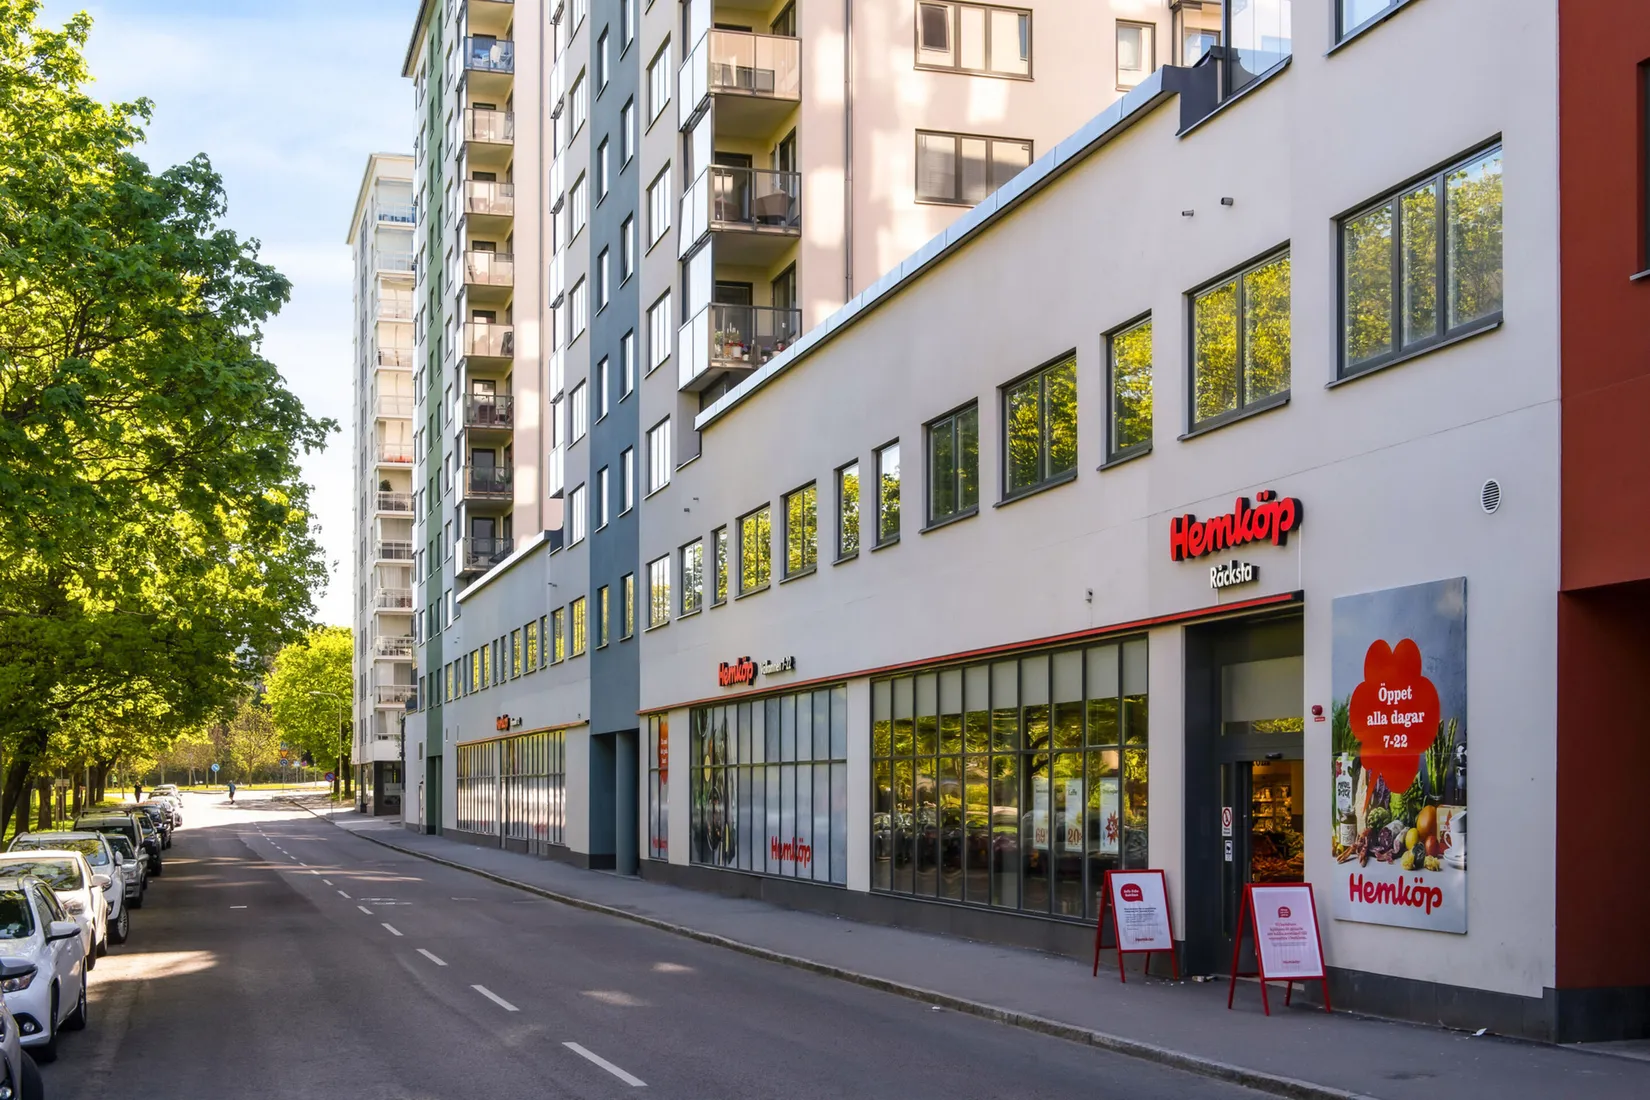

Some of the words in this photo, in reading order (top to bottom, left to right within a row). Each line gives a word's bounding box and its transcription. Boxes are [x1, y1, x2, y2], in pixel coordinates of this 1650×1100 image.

[1170, 490, 1300, 561] Hemköp
[1210, 560, 1254, 588] Råcksta
[718, 656, 757, 686] Hemköp
[1378, 683, 1412, 705] Öppet
[1367, 711, 1388, 726] alla
[1391, 710, 1425, 728] dagar
[1383, 734, 1408, 748] 7-22
[1349, 873, 1443, 915] Hemköp
